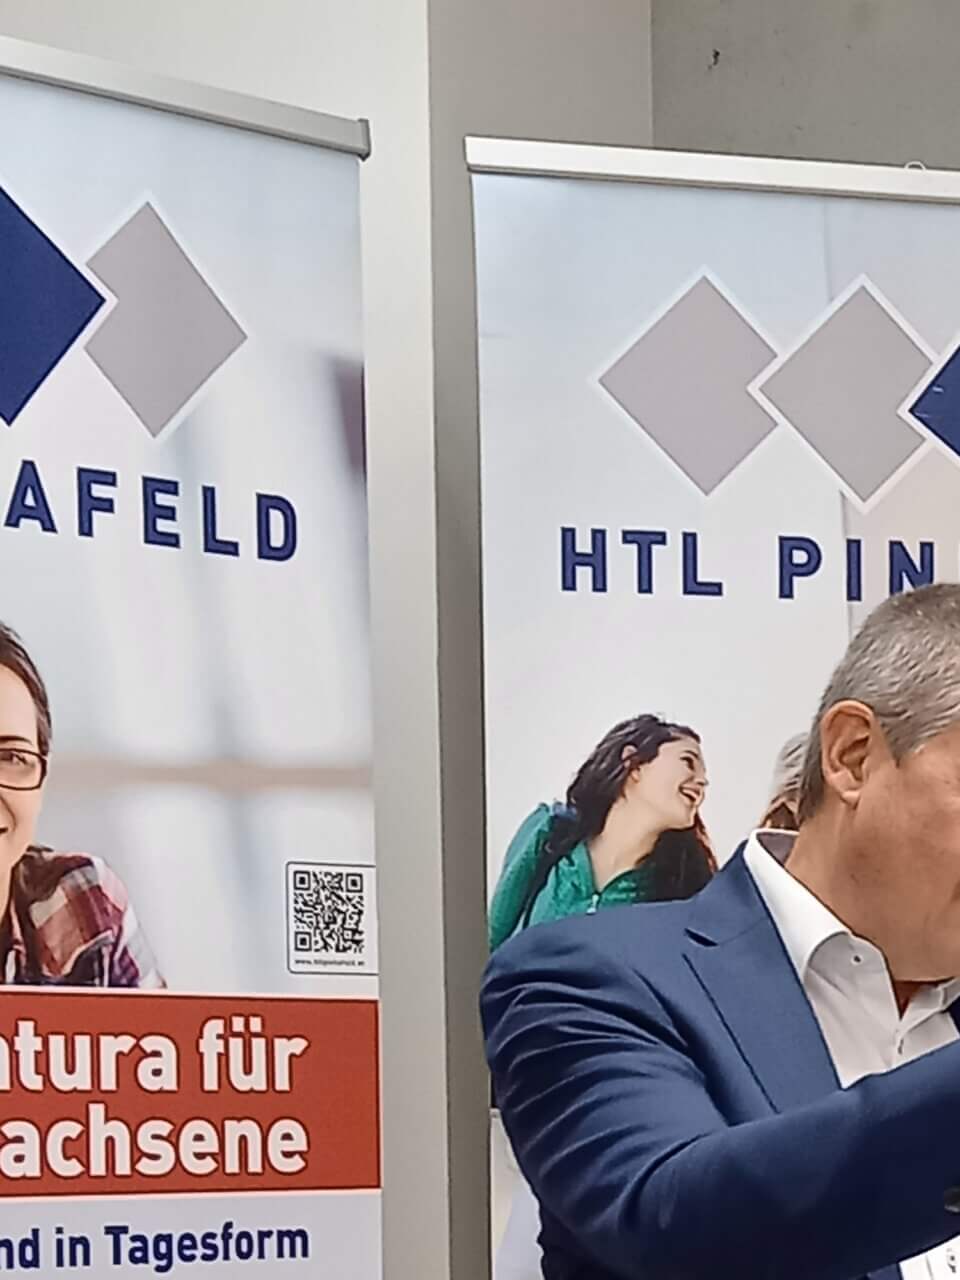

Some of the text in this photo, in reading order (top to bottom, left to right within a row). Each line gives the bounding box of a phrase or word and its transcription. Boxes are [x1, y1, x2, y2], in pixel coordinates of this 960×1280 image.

[4, 460, 297, 562] AFELD
[561, 526, 723, 596] HTL
[0, 1016, 309, 1092] tura für
[0, 1103, 309, 1177] achsene
[55, 1227, 91, 1268] in
[104, 1222, 310, 1272] Tagesform
